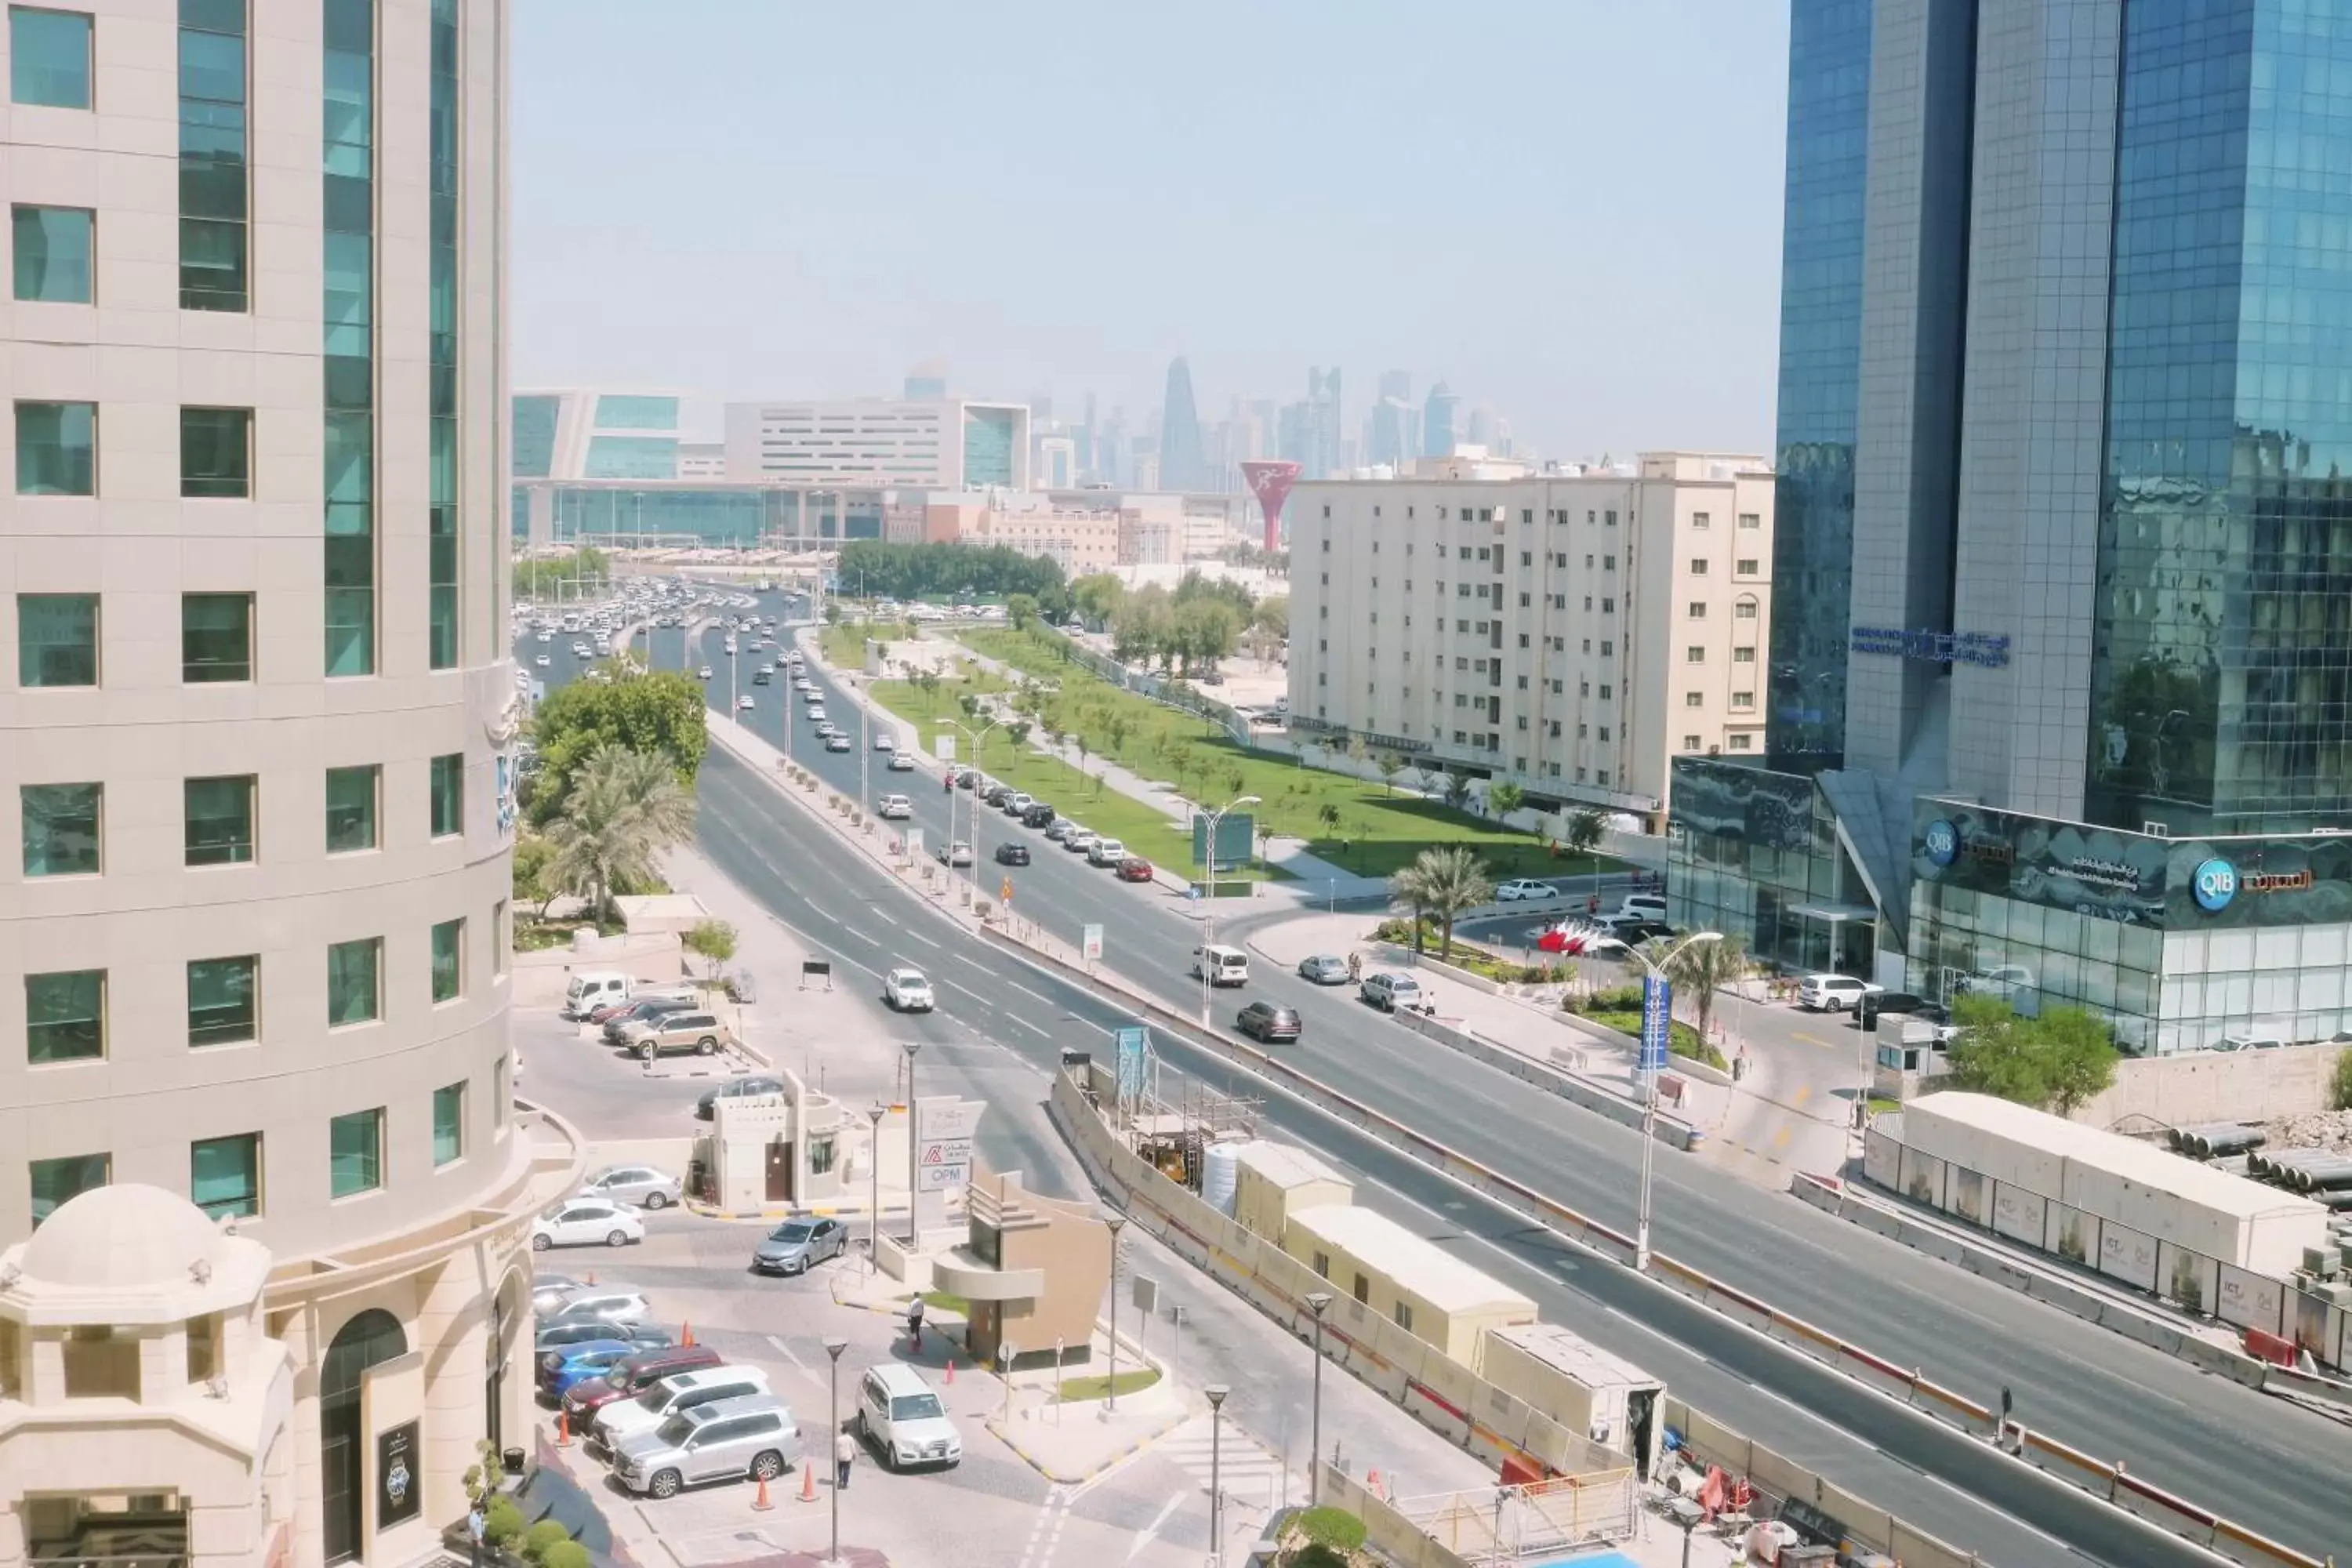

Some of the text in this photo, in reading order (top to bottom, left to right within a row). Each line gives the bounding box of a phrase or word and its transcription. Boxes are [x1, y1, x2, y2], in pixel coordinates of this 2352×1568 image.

[1926, 833, 1951, 853] QIB
[2201, 872, 2234, 896] QIB
[931, 1168, 960, 1181] OPM
